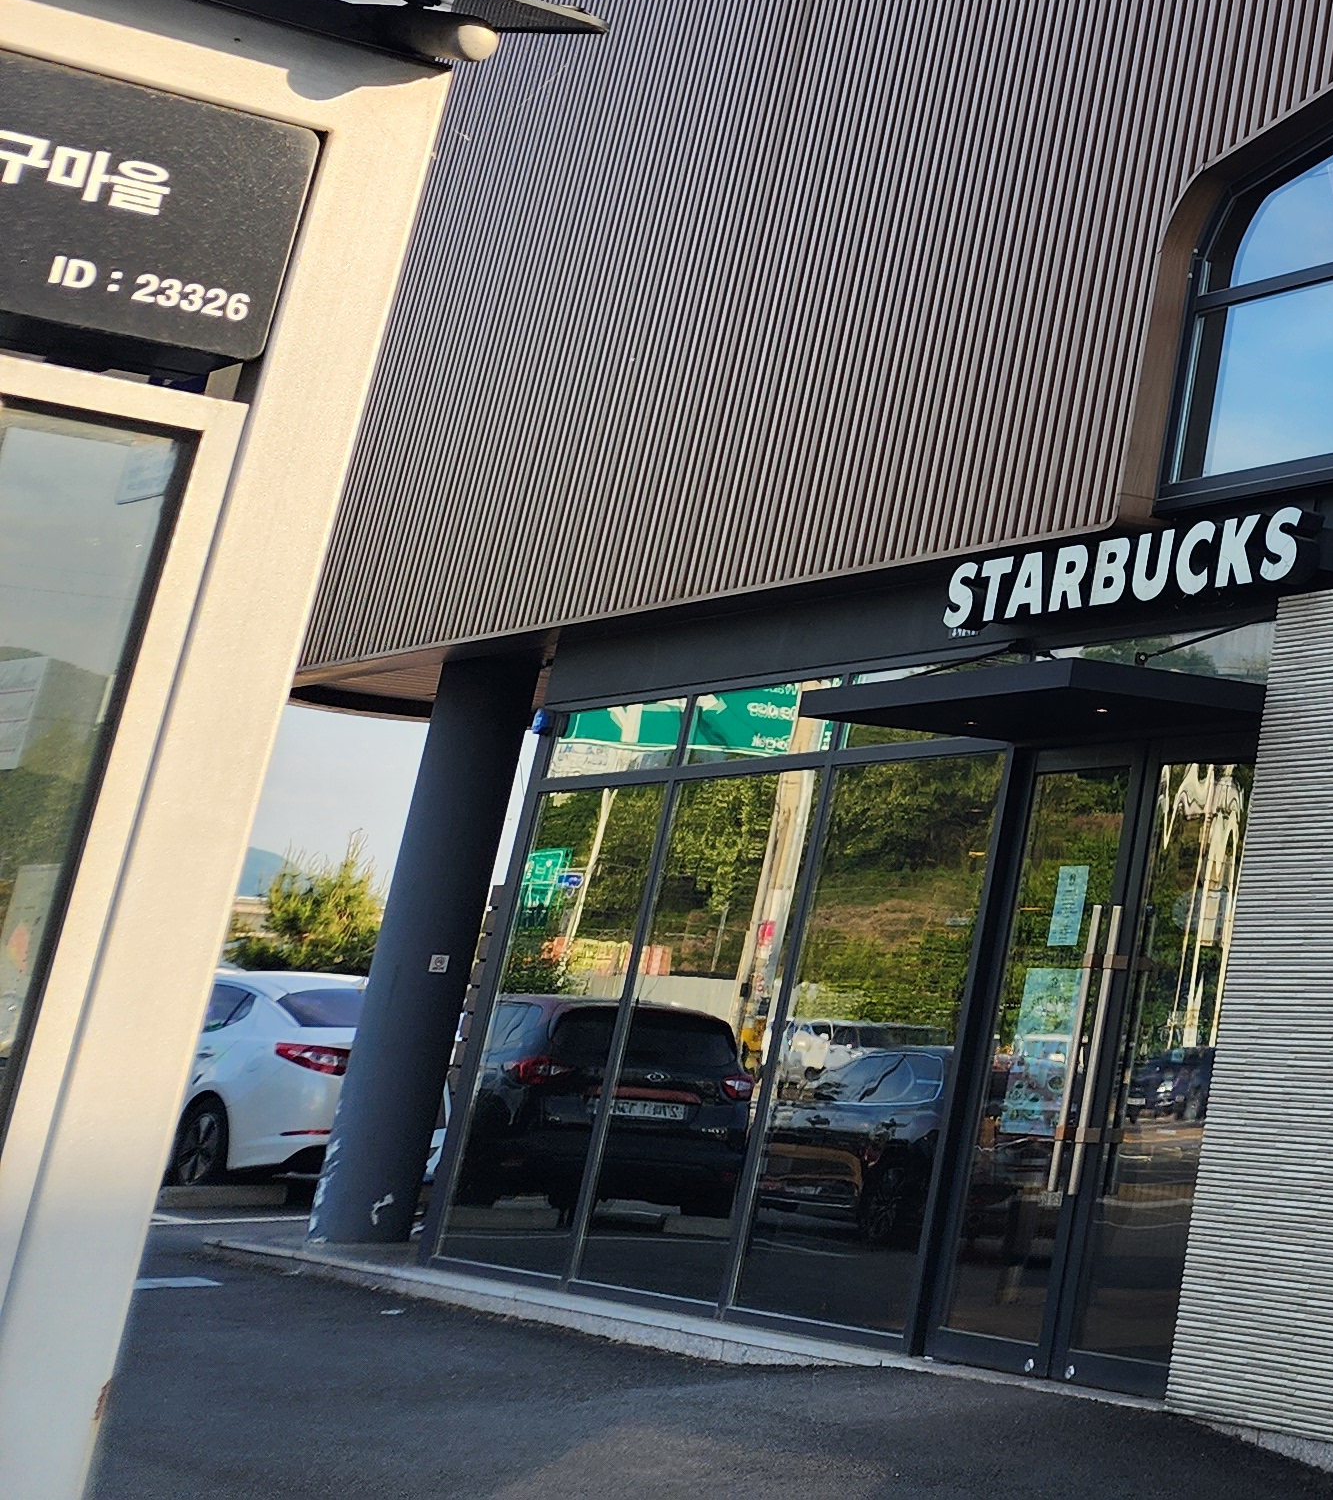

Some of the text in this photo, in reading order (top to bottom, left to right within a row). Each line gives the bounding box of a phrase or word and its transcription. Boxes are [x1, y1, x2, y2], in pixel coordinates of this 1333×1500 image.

[0, 129, 171, 216] 구마을
[47, 255, 98, 289] ID
[130, 273, 250, 322] 23326
[942, 506, 1302, 629] STARBUCKS
